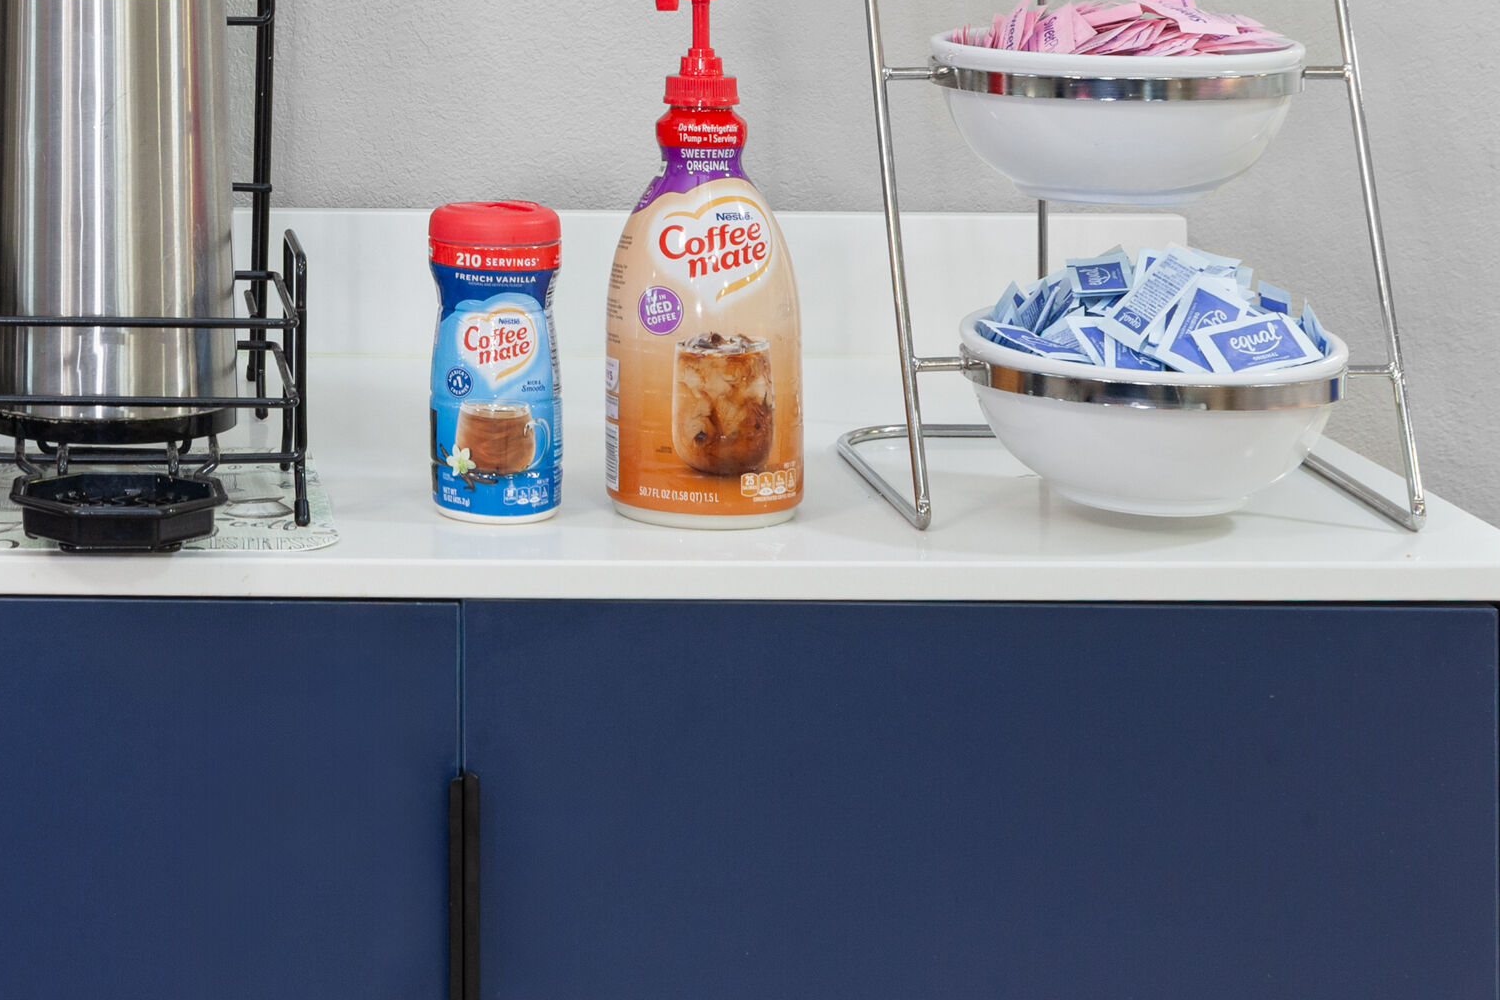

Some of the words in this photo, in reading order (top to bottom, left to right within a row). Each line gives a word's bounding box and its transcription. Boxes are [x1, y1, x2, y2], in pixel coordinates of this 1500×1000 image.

[678, 123, 687, 131] Do
[688, 123, 701, 132] Not
[683, 133, 702, 144] Pump
[713, 134, 737, 144] Serving
[681, 148, 735, 159] SWEETENED
[686, 160, 729, 171] ORIGINAL
[659, 222, 761, 260] Coffee
[456, 252, 481, 267] 210
[688, 241, 767, 278] mate
[455, 272, 493, 283] FRENCH
[645, 300, 673, 316] ICED
[647, 312, 677, 326] COFFEE
[464, 326, 528, 351] Coffee
[1230, 322, 1283, 352] equal
[479, 340, 530, 364] mate
[521, 384, 546, 393] Smooth
[652, 488, 660, 498] FL
[661, 489, 671, 500] OZ
[690, 491, 703, 503] QT)
